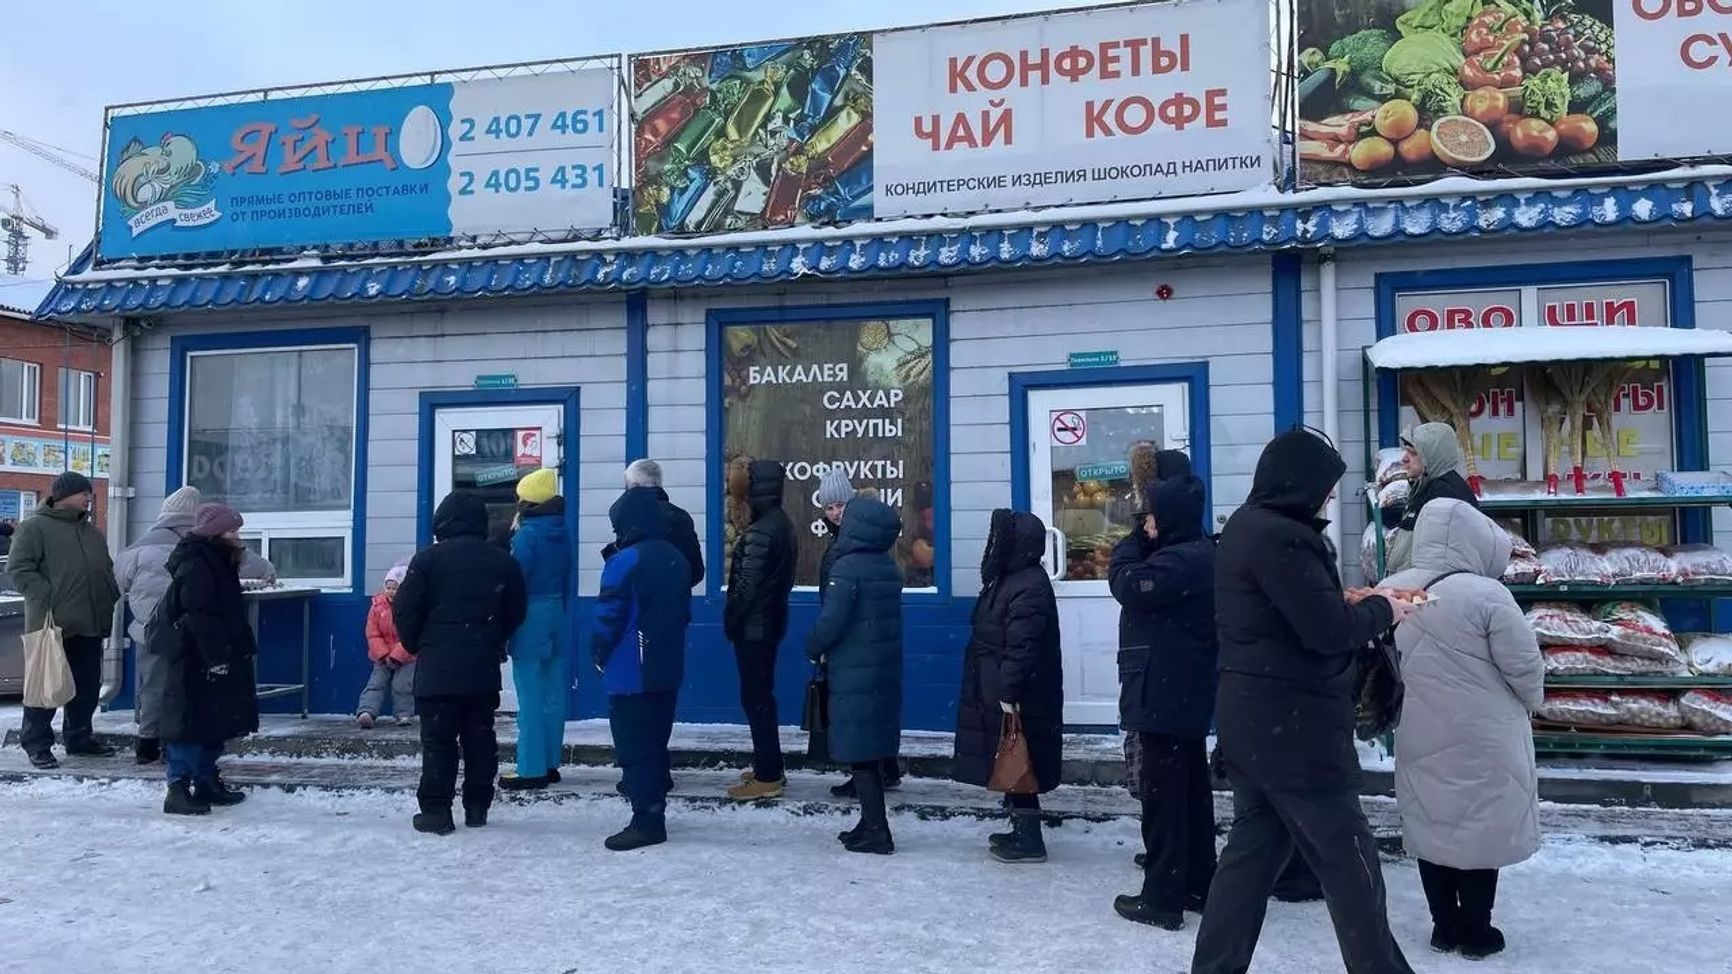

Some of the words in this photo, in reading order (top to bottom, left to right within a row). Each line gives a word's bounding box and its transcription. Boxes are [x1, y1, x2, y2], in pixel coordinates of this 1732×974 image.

[948, 33, 1190, 94] КОНФЕТЫ
[458, 118, 475, 142] 2
[485, 114, 542, 139] 407
[550, 108, 604, 135] 461
[914, 98, 1013, 151] ЧАЙ
[1085, 88, 1229, 139] КОФЕ
[458, 171, 475, 195] 2
[484, 167, 540, 193] 405
[549, 163, 604, 189] 431
[885, 174, 1007, 197] КОНДИТЕРСКИЕ
[1012, 169, 1087, 189] ИЗДЕЛИЯ
[1092, 161, 1177, 181] ШОКОЛАД
[1182, 154, 1261, 174] НАПИТКИ
[231, 191, 284, 207] ПРЯМЫЕ
[288, 188, 352, 203] ОПТОВЫЕ
[356, 183, 429, 200] ПОСТАВКИ
[231, 211, 247, 223] ОТ
[251, 200, 374, 221] ПРОИЗВОДИТЕЛЕЙ
[749, 363, 848, 384] БАКАЛЕЯ
[823, 388, 904, 410] САХАР
[825, 418, 903, 439] КРУПЫ
[780, 460, 904, 480] ХОФРУКТЫ
[1080, 464, 1128, 477] ОТКРЫТО
